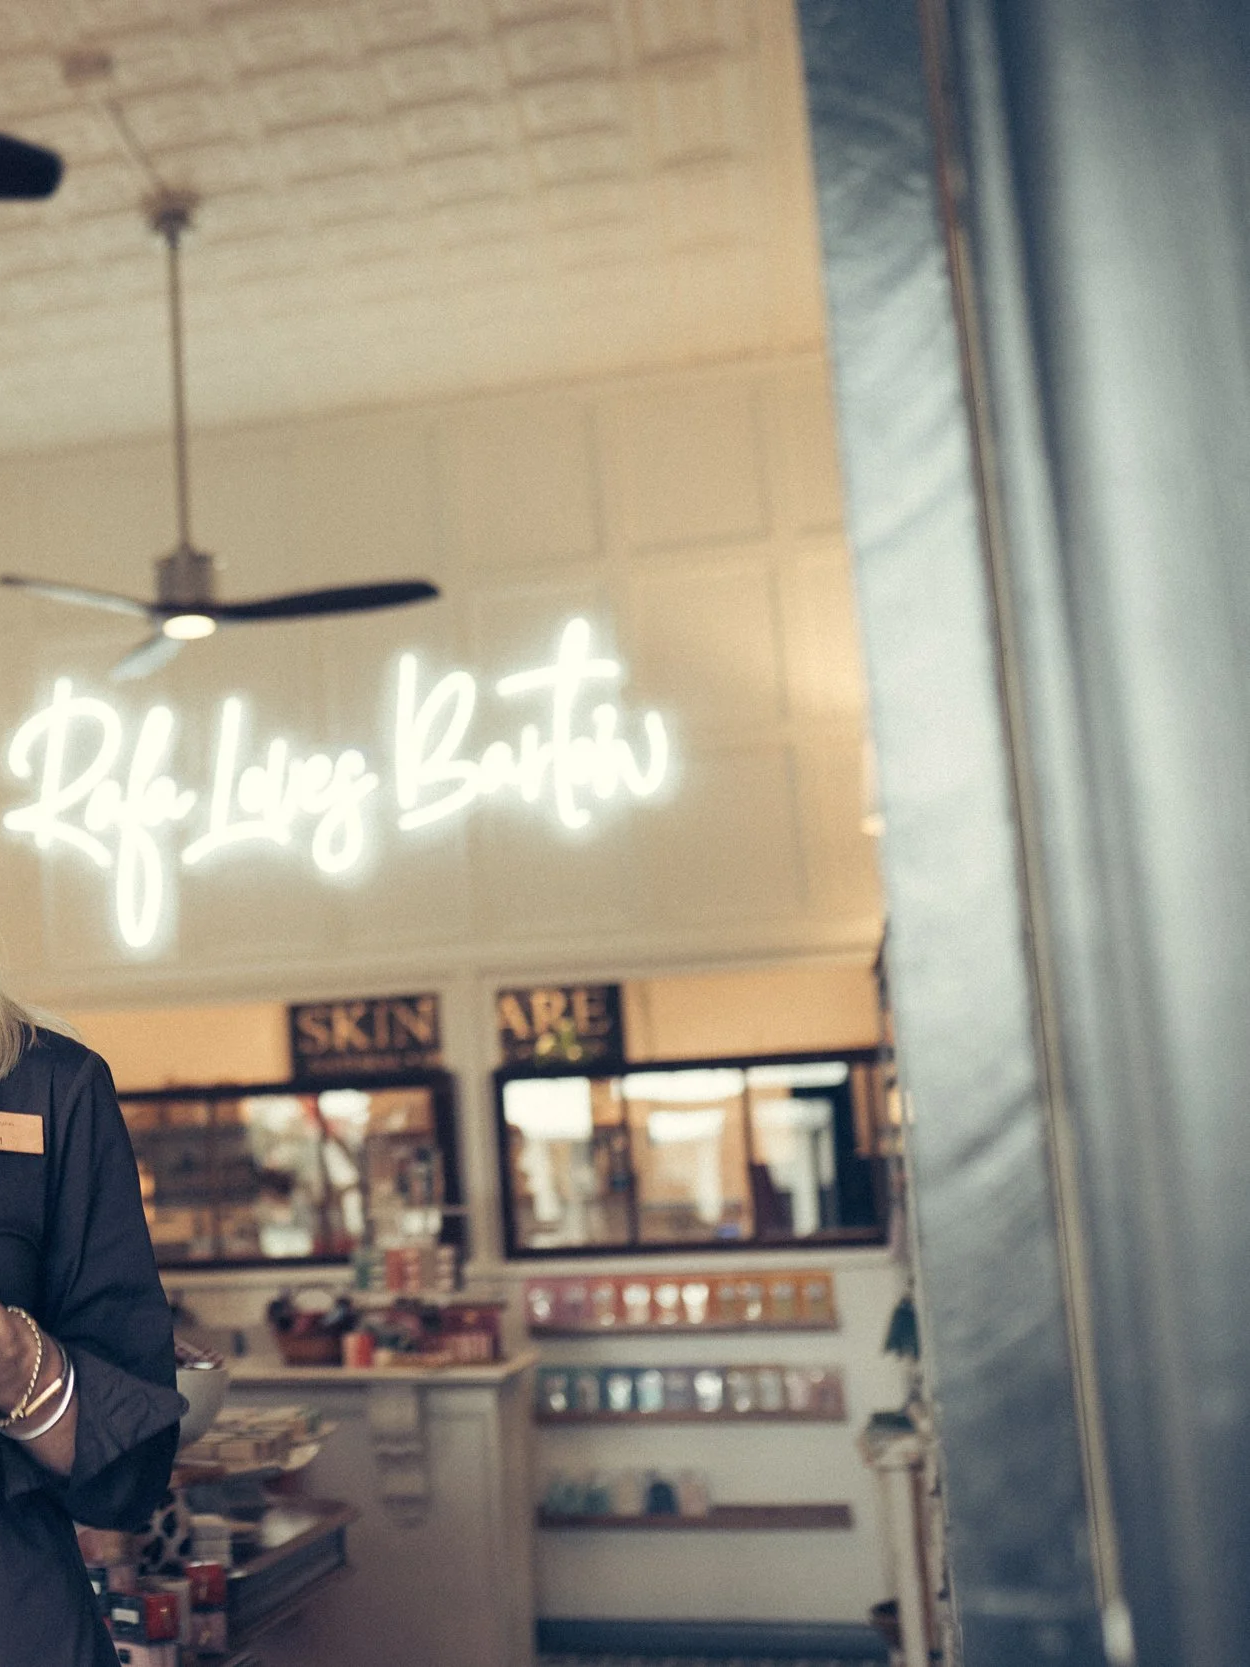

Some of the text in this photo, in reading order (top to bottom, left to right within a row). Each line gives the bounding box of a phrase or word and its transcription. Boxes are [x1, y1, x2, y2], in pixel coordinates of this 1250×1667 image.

[182, 697, 379, 873] Loves
[296, 997, 438, 1053] SKIN
[499, 985, 610, 1041] ARE
